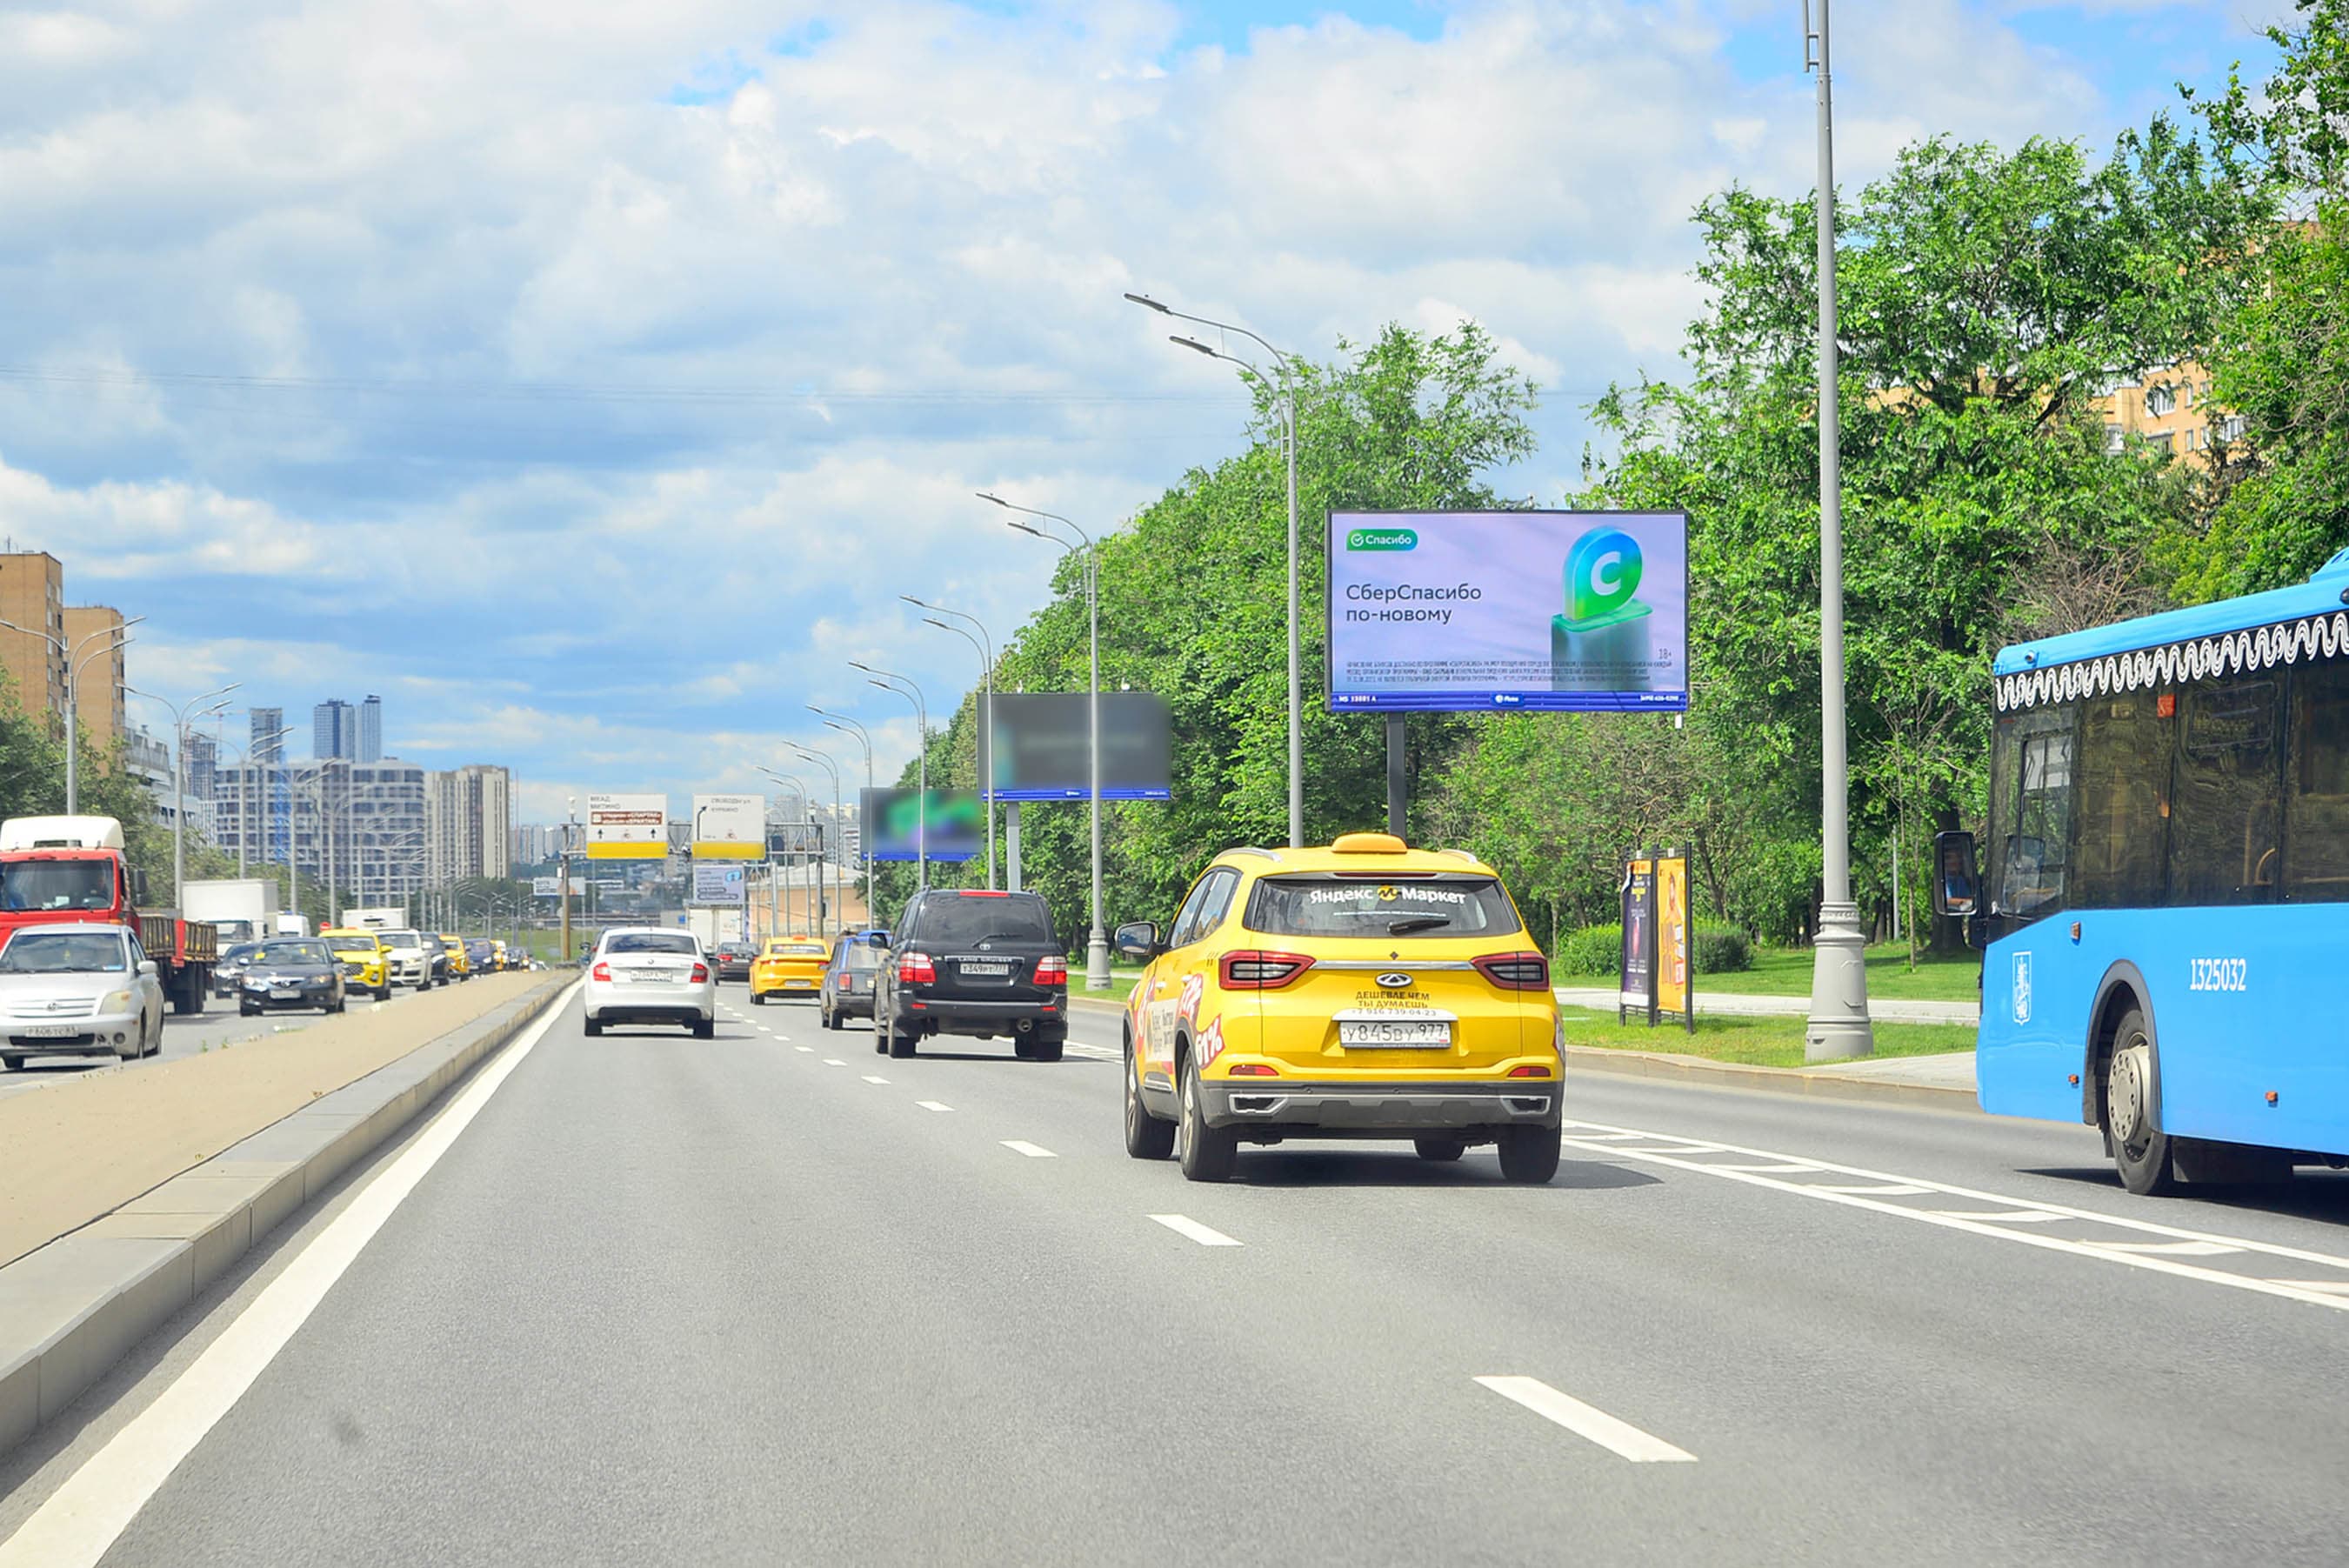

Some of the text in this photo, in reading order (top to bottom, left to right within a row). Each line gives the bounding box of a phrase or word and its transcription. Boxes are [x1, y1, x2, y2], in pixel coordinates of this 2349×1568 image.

[1365, 534, 1412, 545] Спасибо
[1346, 583, 1482, 604] СберСпасибо
[1346, 610, 1452, 624] по-новому
[1658, 648, 1672, 659] 18+
[1310, 888, 1466, 904] Яндекс Маркет
[2190, 958, 2246, 991] 1325032
[1418, 1024, 1445, 1037] 977
